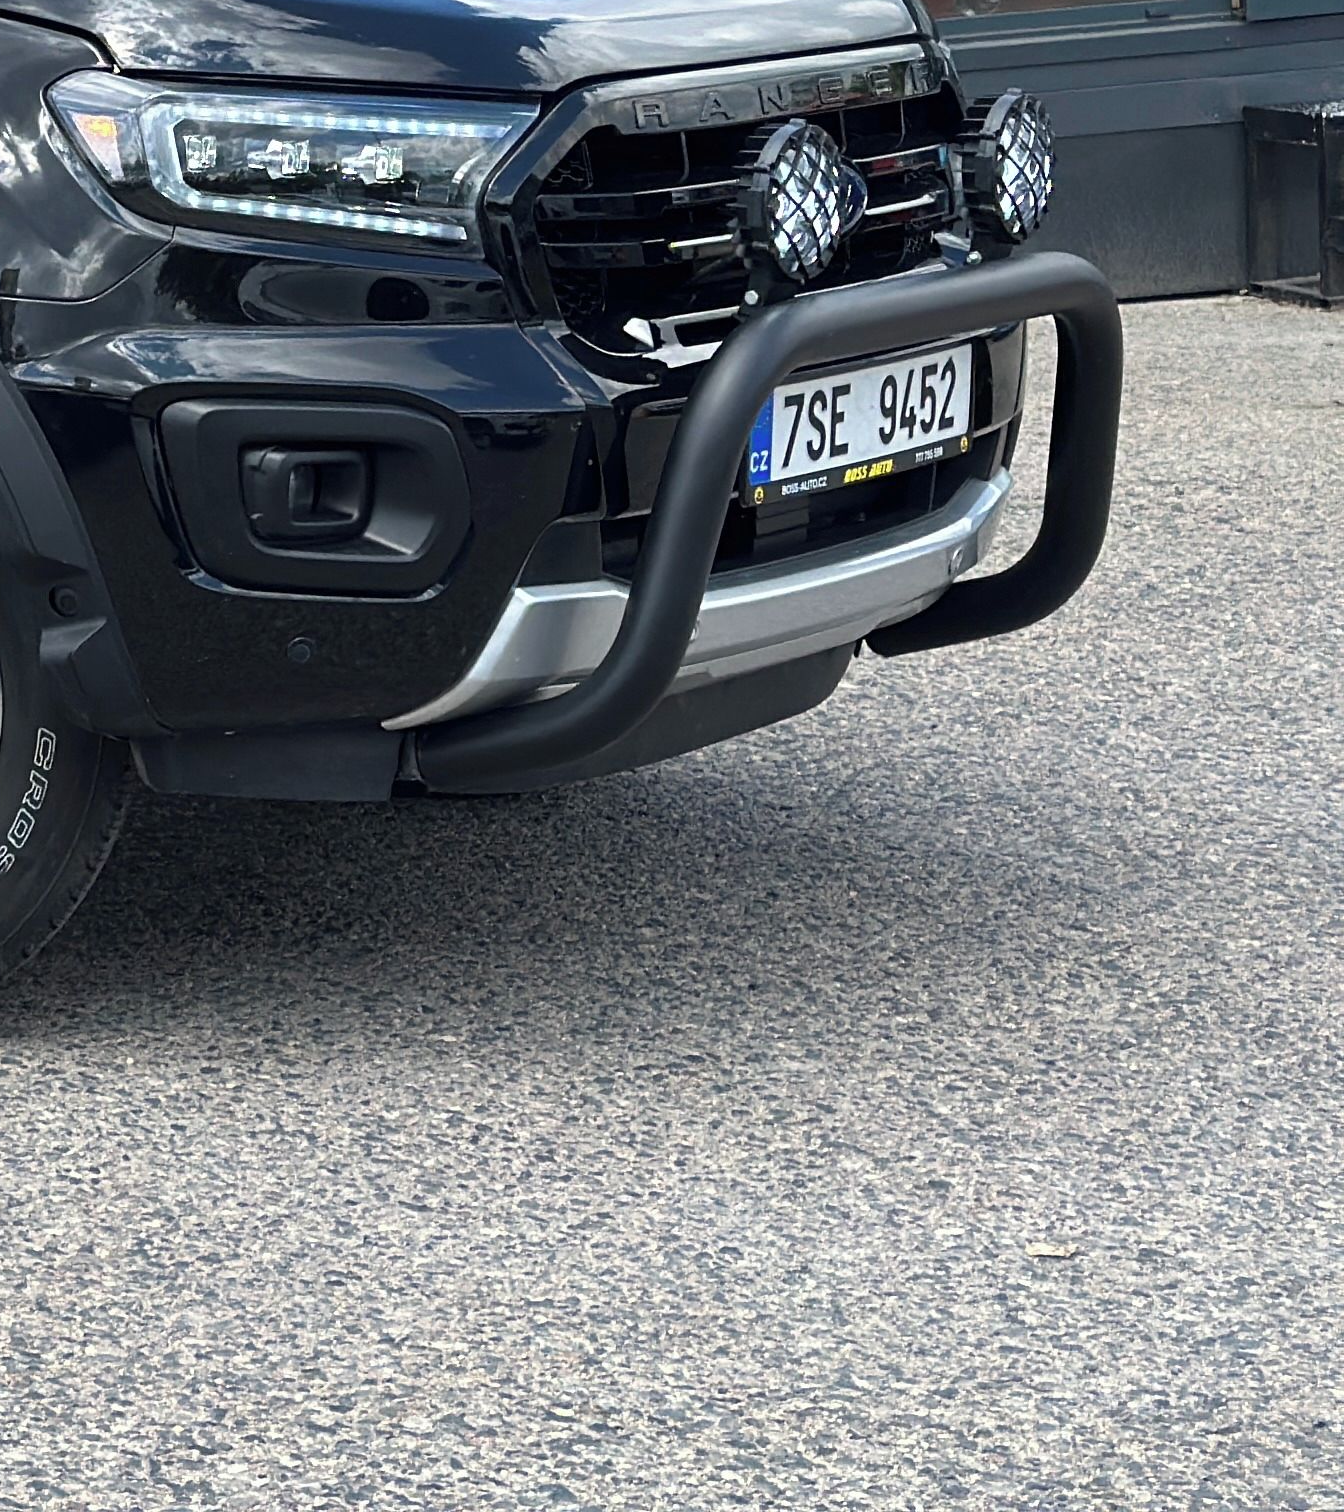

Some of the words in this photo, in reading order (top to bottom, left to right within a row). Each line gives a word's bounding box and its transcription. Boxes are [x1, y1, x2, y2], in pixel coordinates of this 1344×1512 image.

[632, 61, 932, 129] RANGER
[782, 381, 852, 469] 7SE
[878, 355, 958, 447] 9452
[750, 449, 770, 473] CZ
